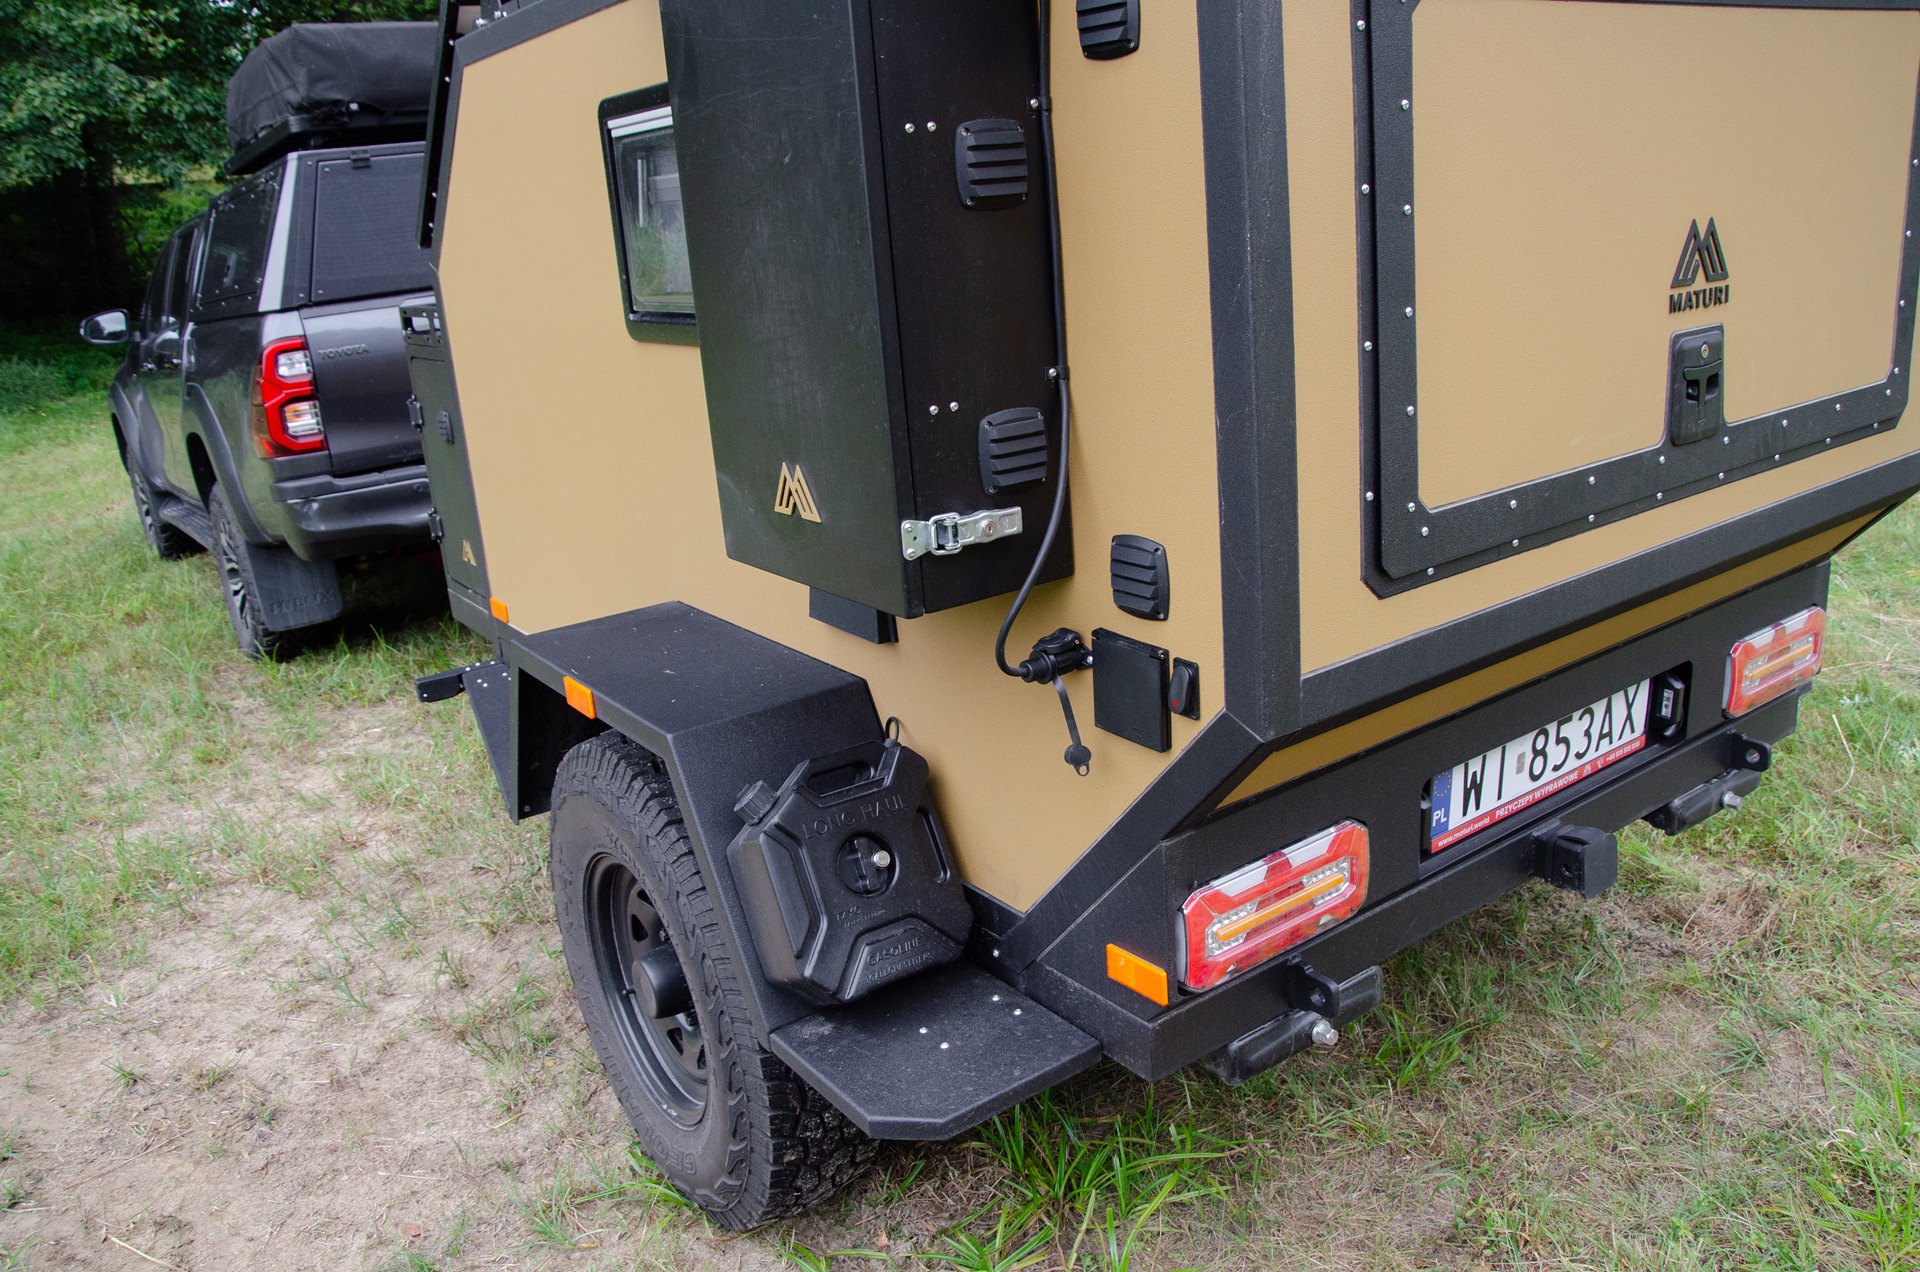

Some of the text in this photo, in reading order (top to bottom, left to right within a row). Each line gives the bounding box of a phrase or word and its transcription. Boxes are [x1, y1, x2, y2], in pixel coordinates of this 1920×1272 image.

[1668, 284, 1730, 315] MATURI
[317, 343, 370, 360] TOYOTA
[271, 589, 335, 615] HILUX
[1462, 681, 1642, 818] WI 853AX
[801, 794, 909, 840] LONG HAUL
[1432, 808, 1448, 827] PL
[1438, 815, 1491, 847] www.maturi.world
[1495, 793, 1535, 819] PRZYCZEPY
[1534, 770, 1579, 800] WYPRAWOWE
[867, 937, 922, 966] GASOLINE
